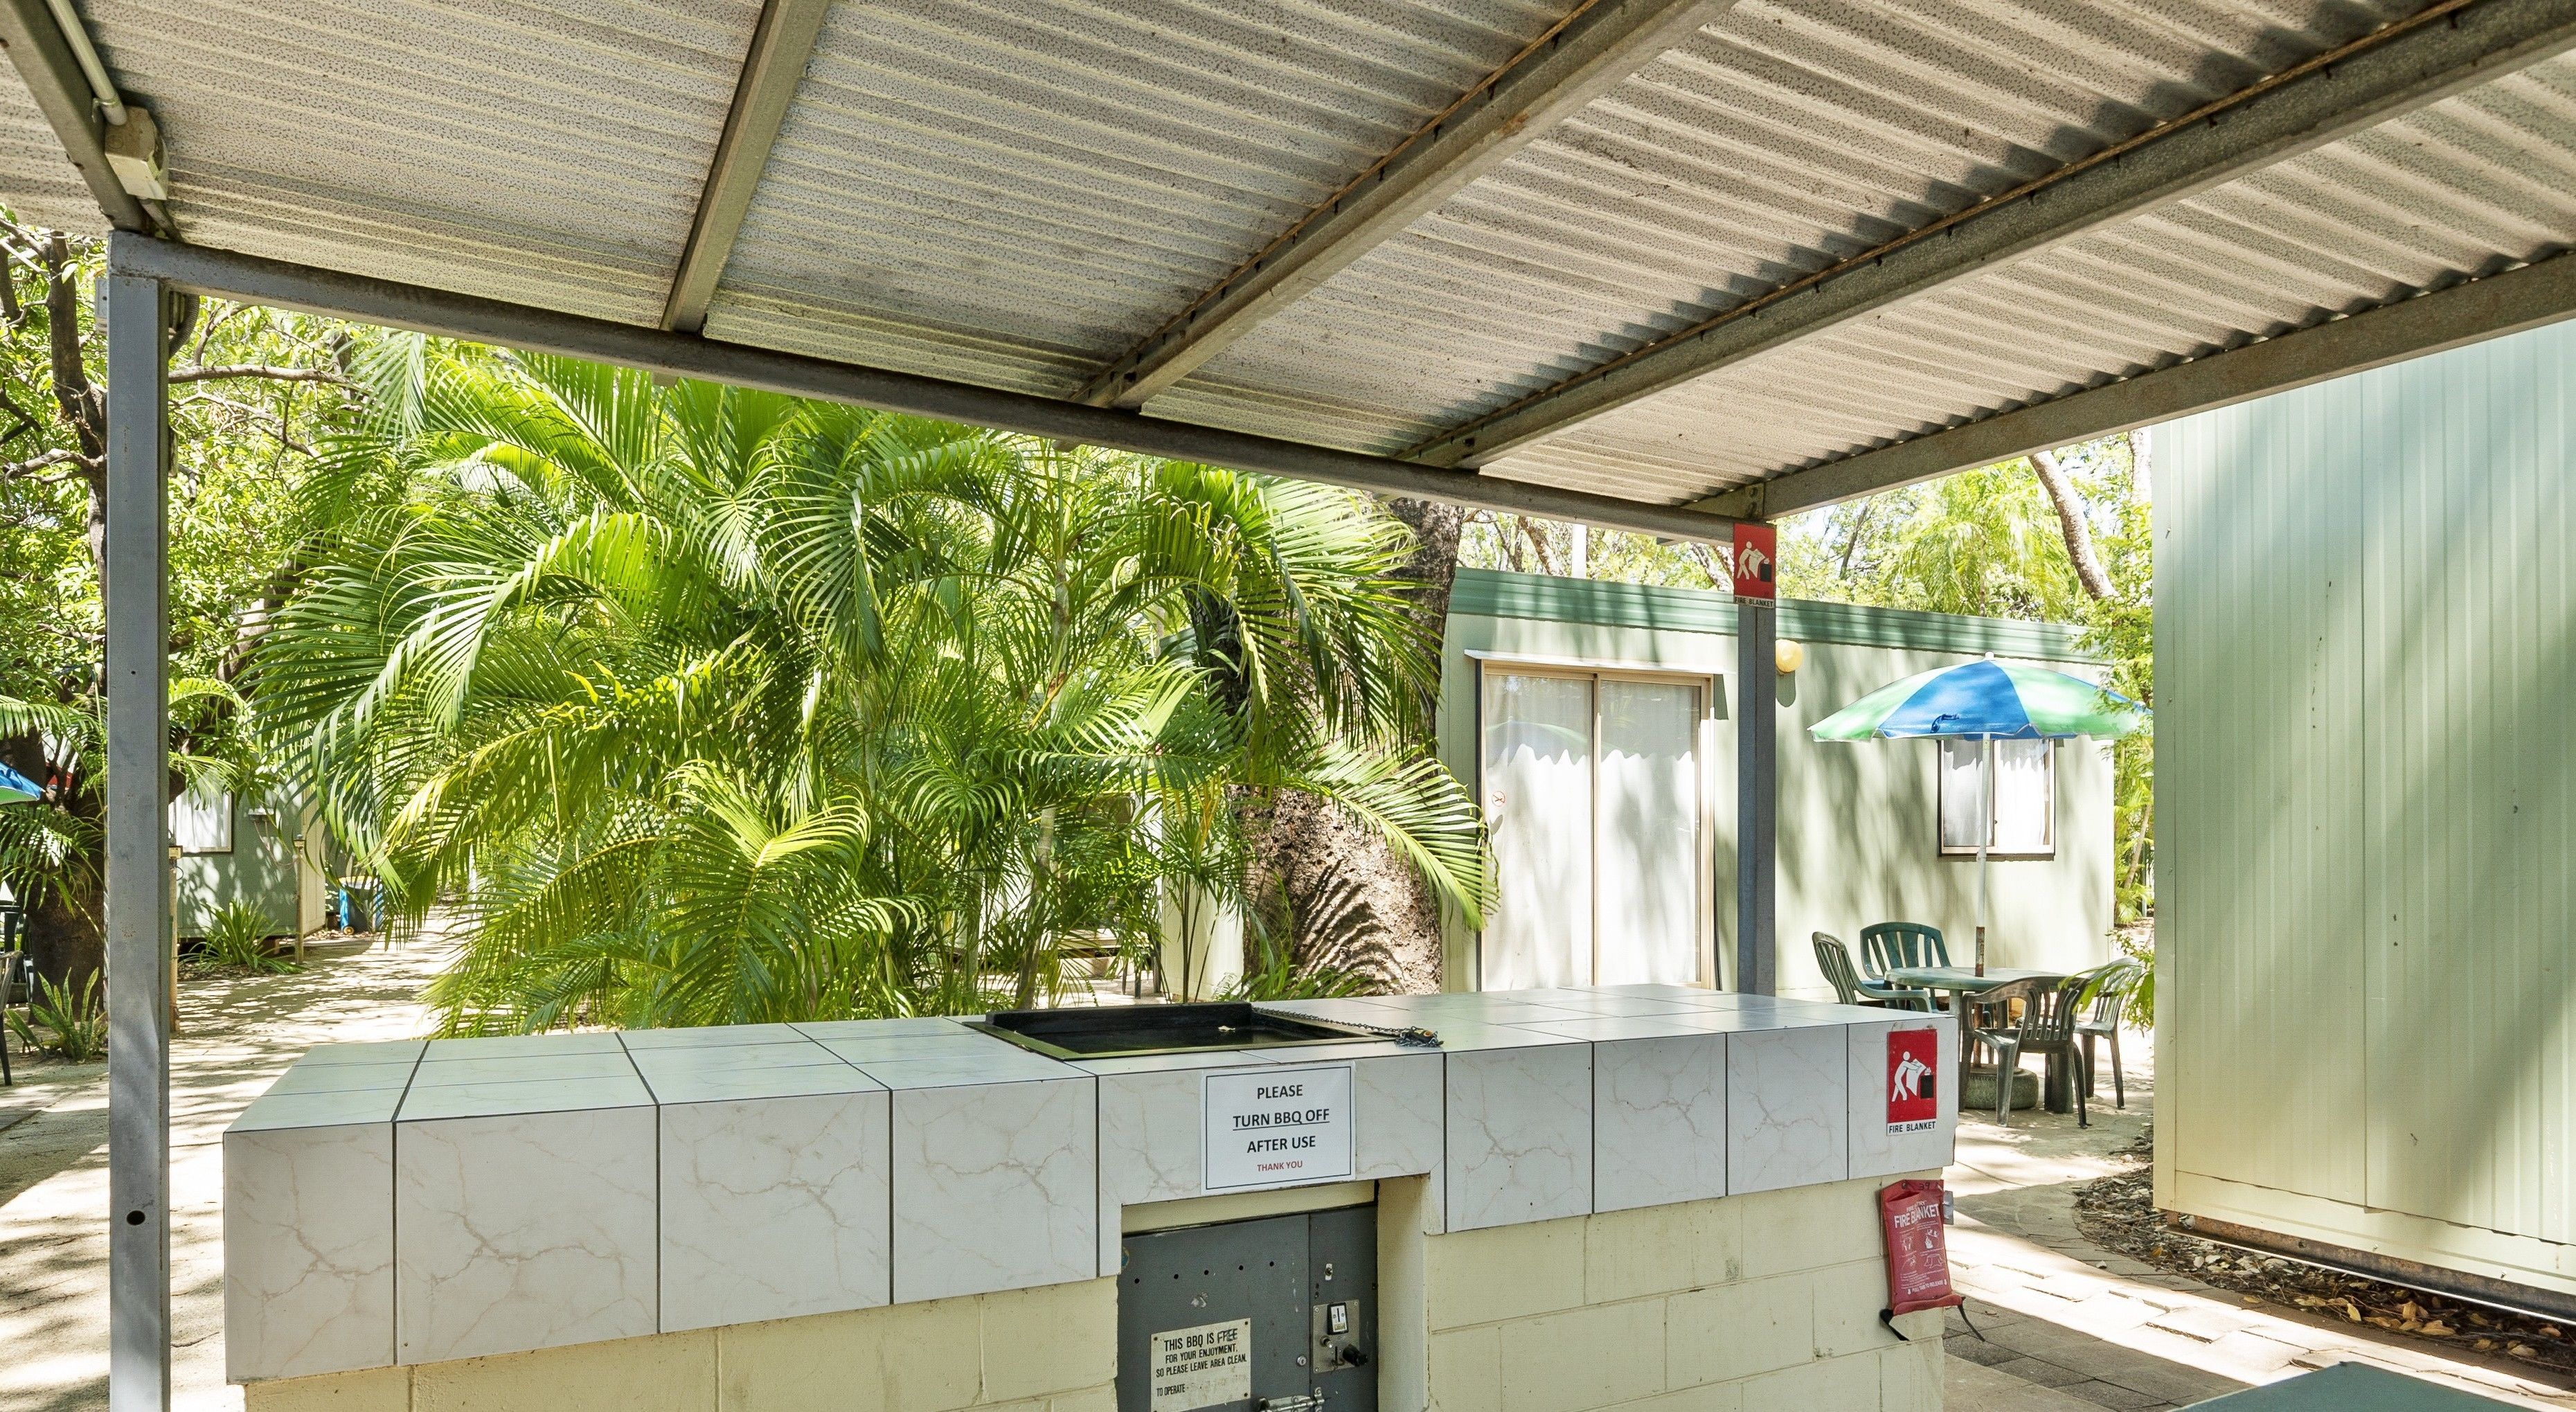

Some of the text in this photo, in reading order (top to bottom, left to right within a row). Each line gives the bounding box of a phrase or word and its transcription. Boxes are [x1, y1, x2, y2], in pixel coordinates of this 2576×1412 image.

[1748, 598, 1773, 607] BLANKET
[1257, 1084, 1303, 1099] PLEASE
[1233, 1109, 1330, 1128] TURN BBQ OFF
[1888, 1121, 1936, 1134] FIRE BLANKET
[1246, 1136, 1316, 1153] AFTER USE
[1257, 1161, 1303, 1172] THANK YOU
[1894, 1212, 1911, 1228] FIRE
[1911, 1203, 1940, 1224] BANKET
[1164, 1337, 1183, 1352] THIS
[1186, 1334, 1203, 1348] BBQ
[1206, 1332, 1215, 1345] IS
[1165, 1343, 1238, 1364] FOR YOUR ENJOYMENT.
[1156, 1368, 1164, 1377] SO
[1166, 1364, 1188, 1376] PLEASE
[1190, 1360, 1208, 1372] LEAVE
[1210, 1359, 1226, 1368] AREA
[1156, 1384, 1186, 1397] TO OPERATE
